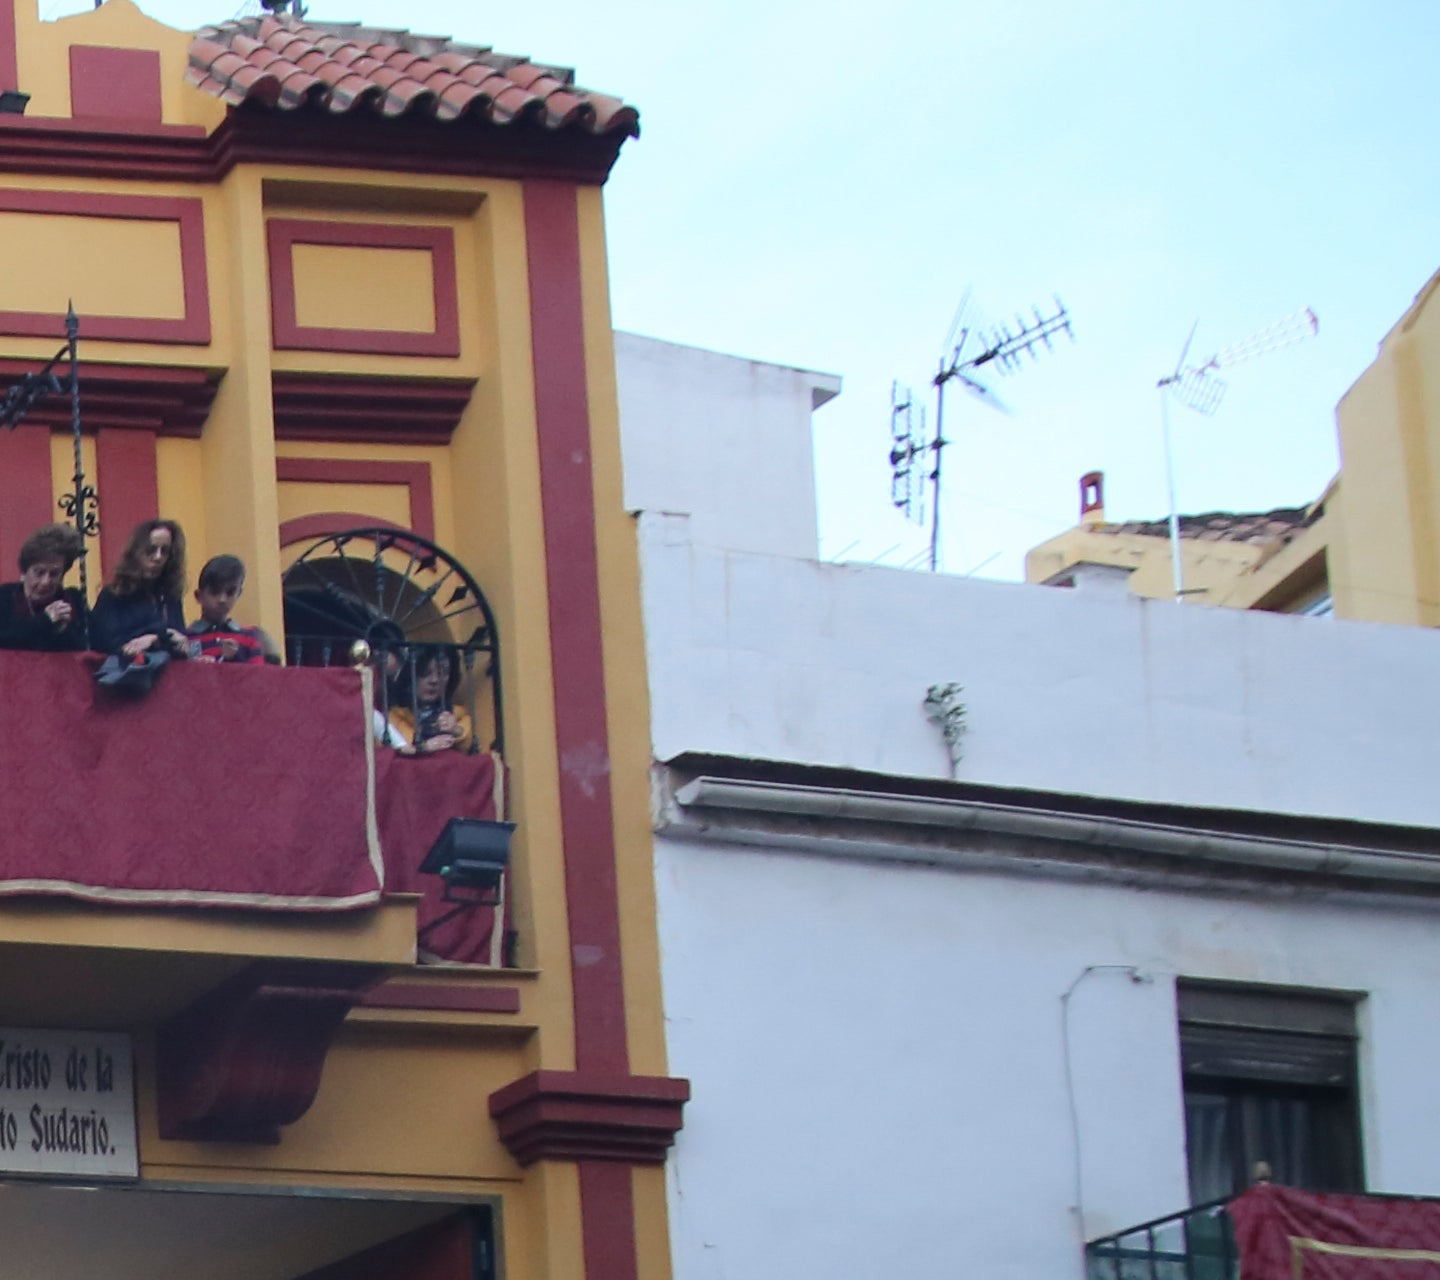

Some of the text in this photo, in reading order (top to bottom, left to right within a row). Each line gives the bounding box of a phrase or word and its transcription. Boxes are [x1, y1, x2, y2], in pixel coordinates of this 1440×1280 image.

[65, 1046, 87, 1092] de
[96, 1047, 113, 1092] la
[30, 1103, 116, 1155] Sudario.
